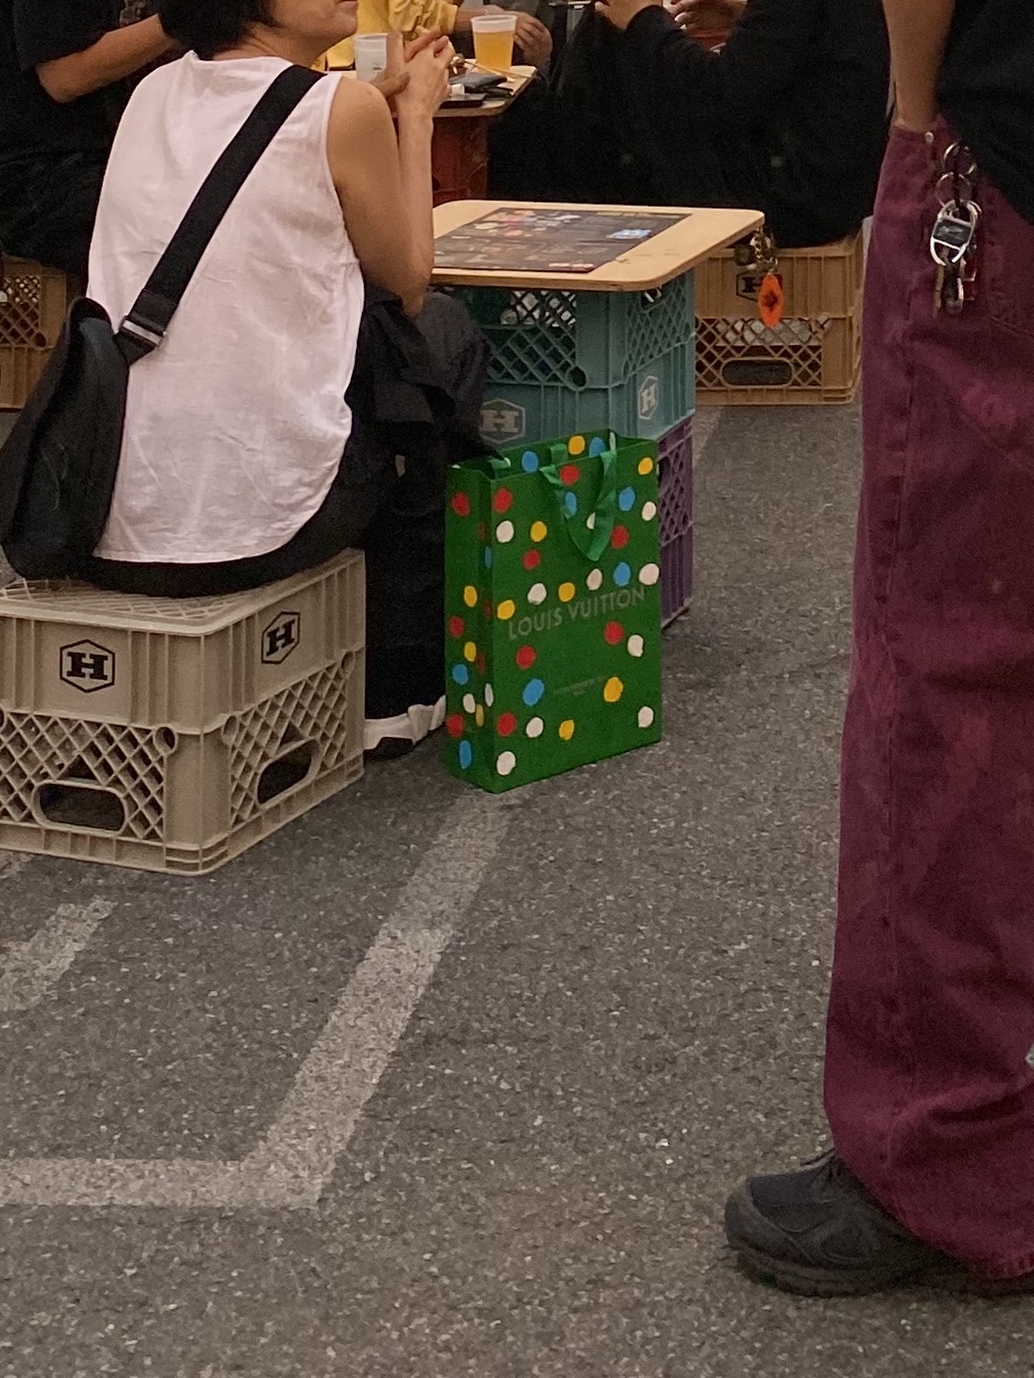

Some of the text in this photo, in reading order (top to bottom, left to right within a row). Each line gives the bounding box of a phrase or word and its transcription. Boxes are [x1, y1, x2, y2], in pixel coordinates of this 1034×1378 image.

[508, 585, 645, 640] LOUIS VUITTON
[66, 651, 109, 682] H
